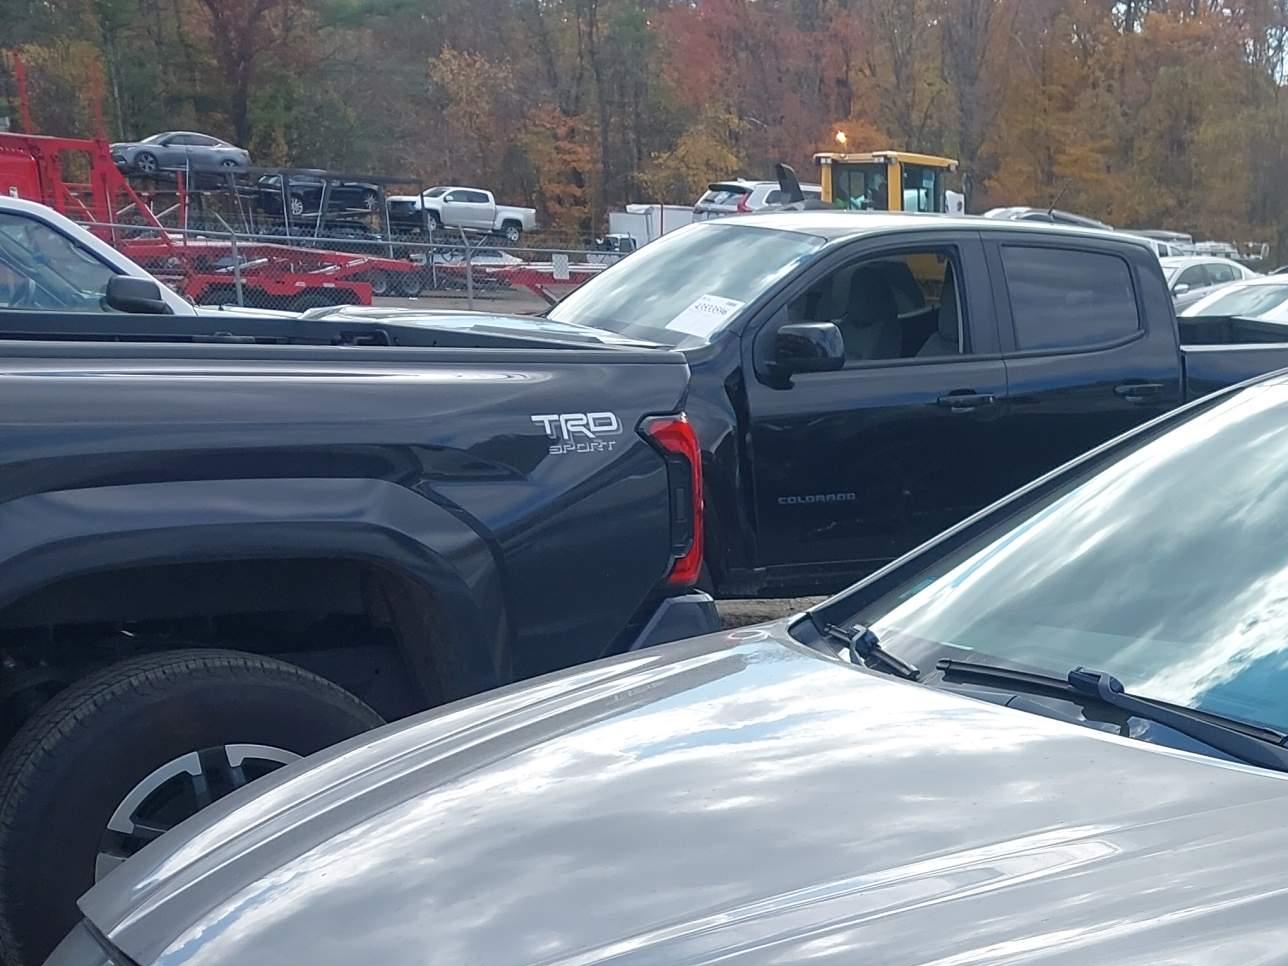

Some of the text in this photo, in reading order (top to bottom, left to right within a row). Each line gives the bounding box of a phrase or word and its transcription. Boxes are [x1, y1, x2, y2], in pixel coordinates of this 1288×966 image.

[531, 412, 620, 440] TRD
[549, 440, 616, 454] SPORT
[778, 493, 856, 504] COLORADO
